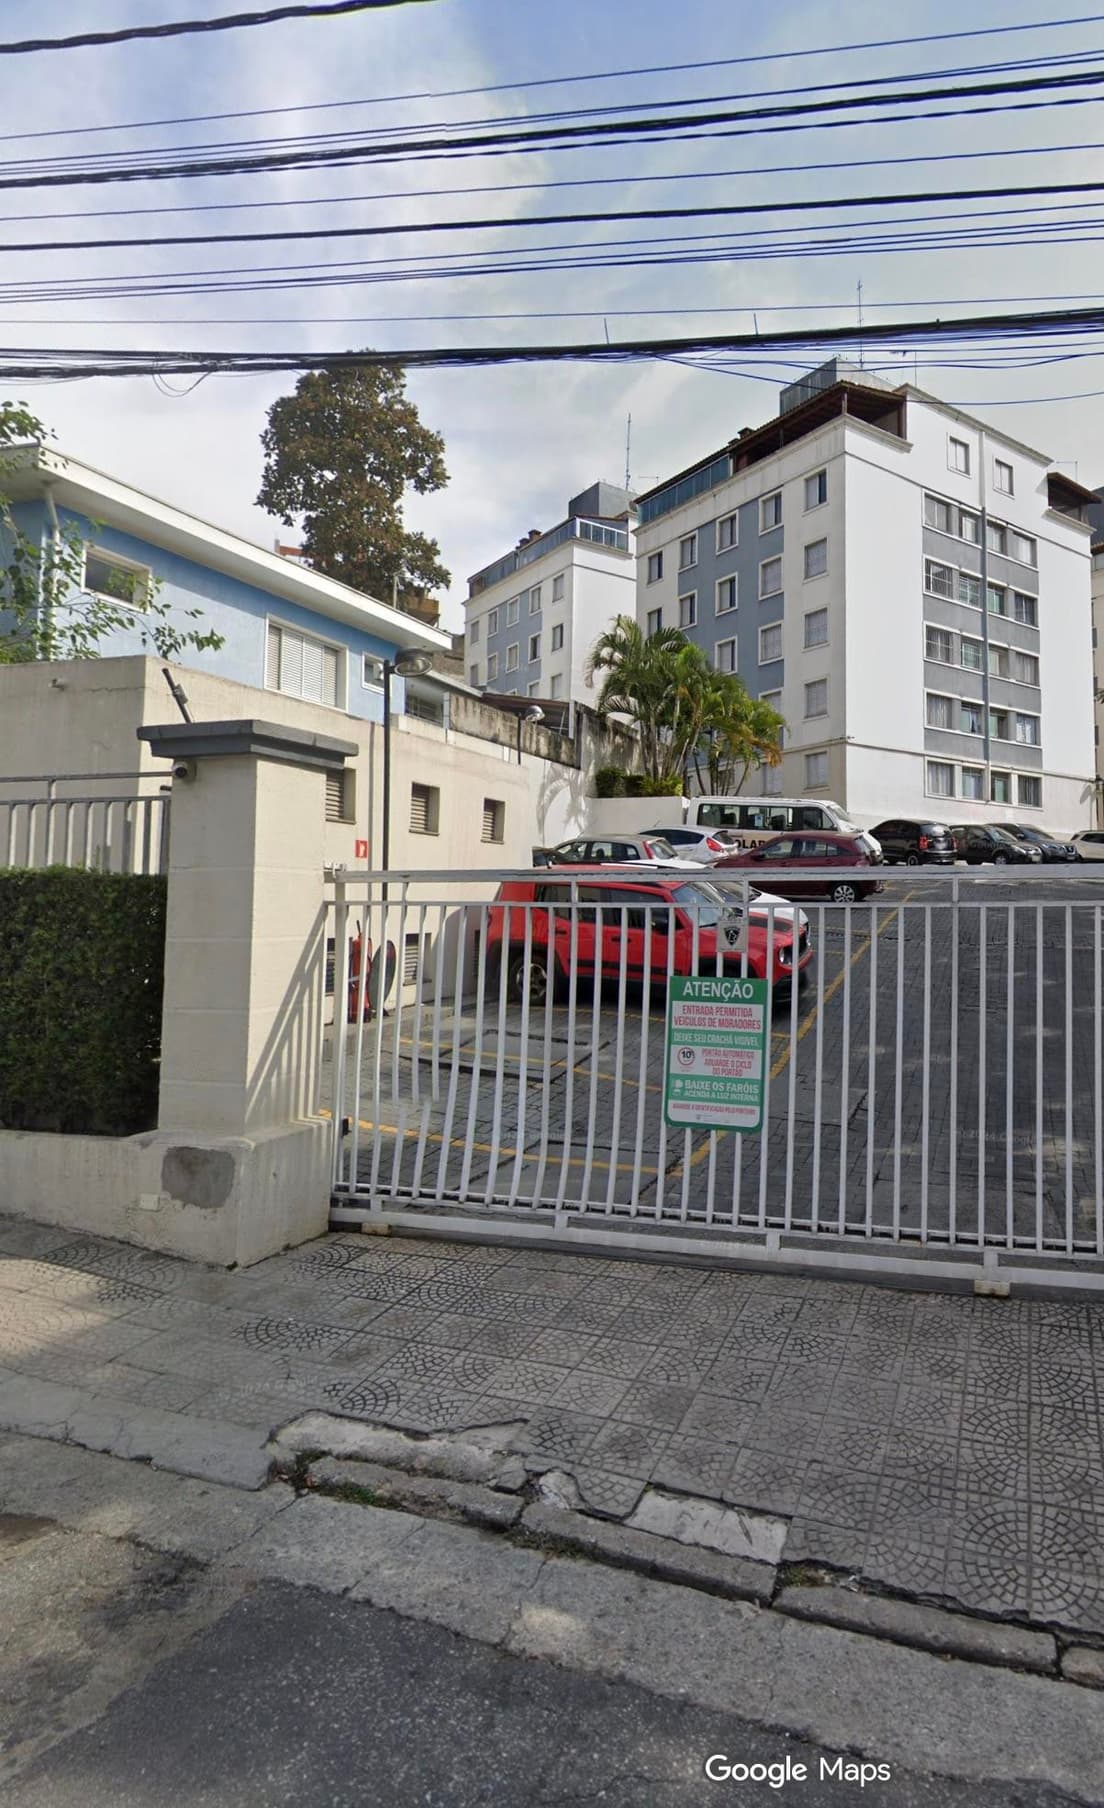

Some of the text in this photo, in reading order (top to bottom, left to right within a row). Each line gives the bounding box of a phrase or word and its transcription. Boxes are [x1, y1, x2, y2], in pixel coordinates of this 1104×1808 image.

[683, 979, 753, 1001] ATENÇÃO
[682, 1005, 753, 1018] ENTRADA PERMITIDA
[707, 1017, 718, 1028] DE
[718, 1018, 761, 1030] MORADORES
[684, 1079, 760, 1094] BAIXE OS FARÓIS
[684, 1089, 710, 1098] ACENDA
[716, 1091, 730, 1099] LUZ
[730, 1093, 759, 1102] INTERNA
